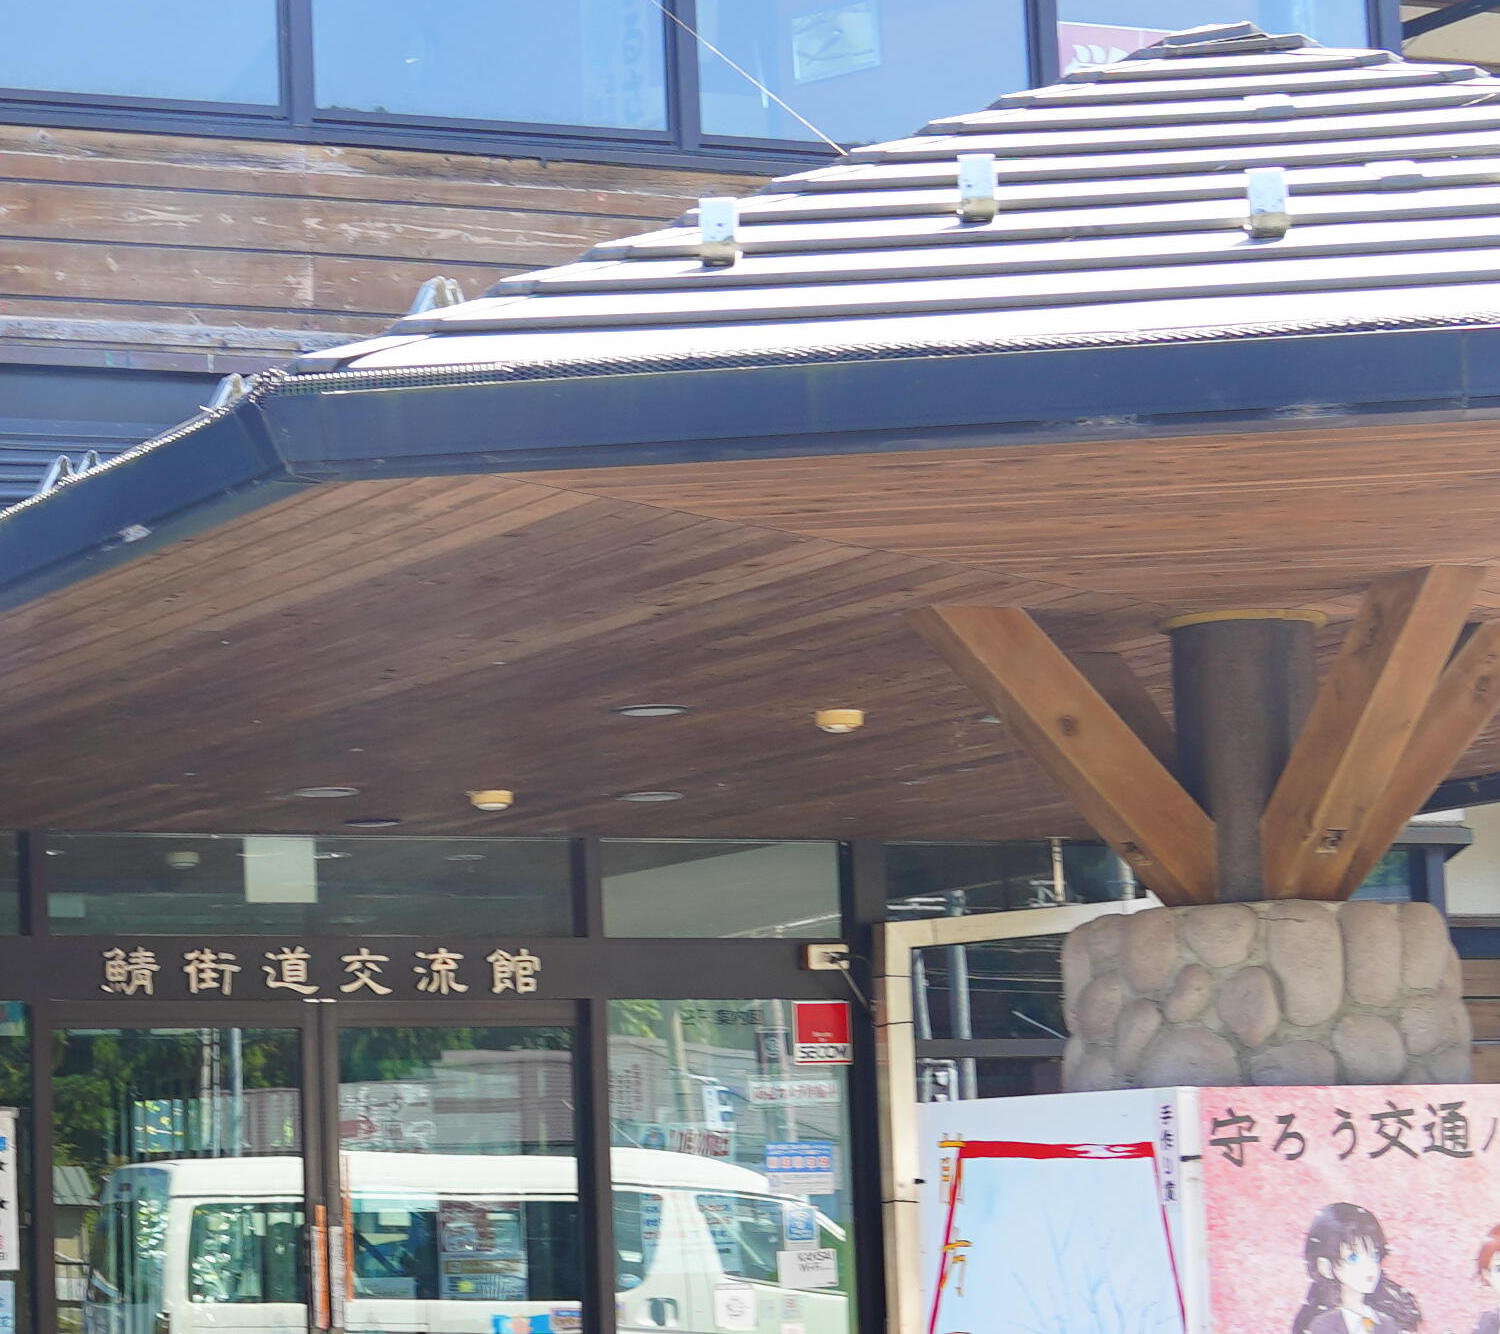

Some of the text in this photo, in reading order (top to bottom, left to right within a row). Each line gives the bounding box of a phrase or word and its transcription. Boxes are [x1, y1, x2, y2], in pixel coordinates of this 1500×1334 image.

[99, 945, 542, 997] 鯖街道交流館
[799, 1045, 848, 1060] SECOM
